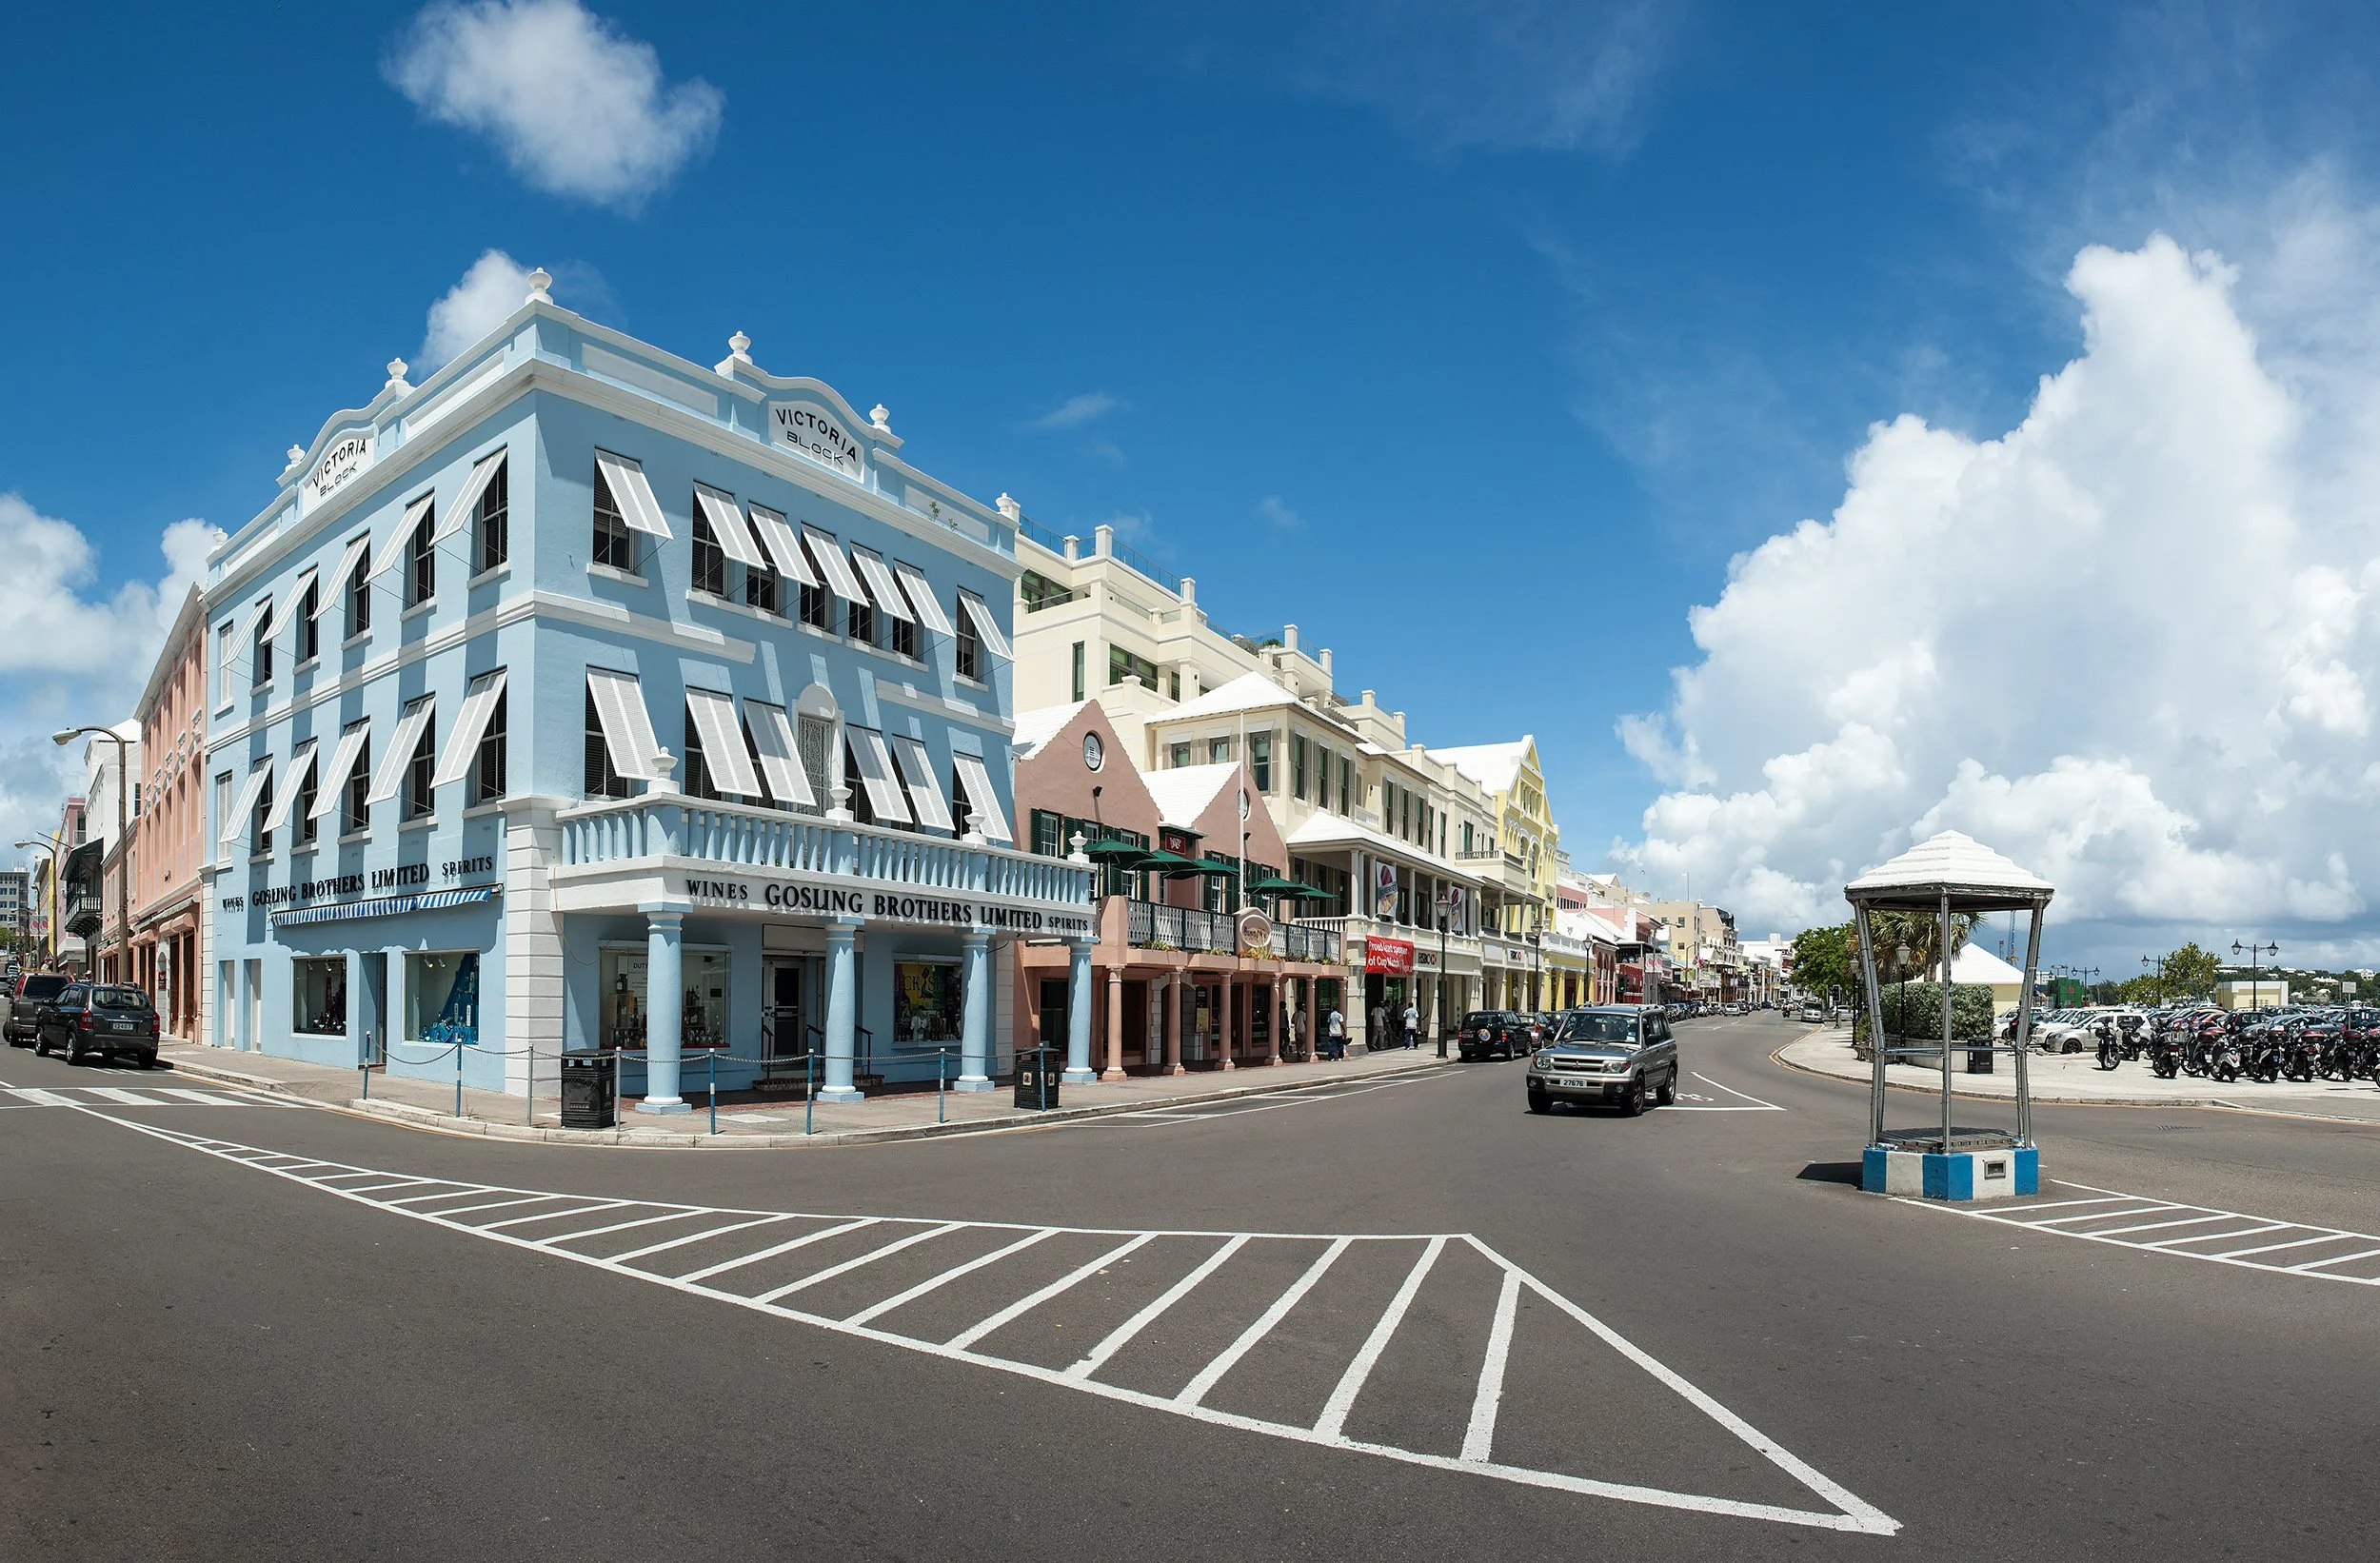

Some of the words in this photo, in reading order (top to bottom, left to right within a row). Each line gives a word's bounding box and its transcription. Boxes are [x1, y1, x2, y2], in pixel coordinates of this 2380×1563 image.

[775, 408, 857, 463] VICTORIA
[786, 430, 844, 466] BLOCK
[312, 438, 367, 487] VICTORIA
[319, 461, 358, 497] BLOCK
[251, 885, 297, 907] GOSLING
[301, 873, 366, 900] BROTHERS
[370, 862, 429, 889] LIMITED
[442, 856, 493, 877] SPIRITS
[685, 879, 748, 900] WINES
[764, 883, 863, 914] GOSLING
[873, 894, 973, 923] BROTHERS
[980, 905, 1042, 930] LIMITED
[1048, 916, 1088, 932] SPIRITS
[1368, 955, 1376, 966] of
